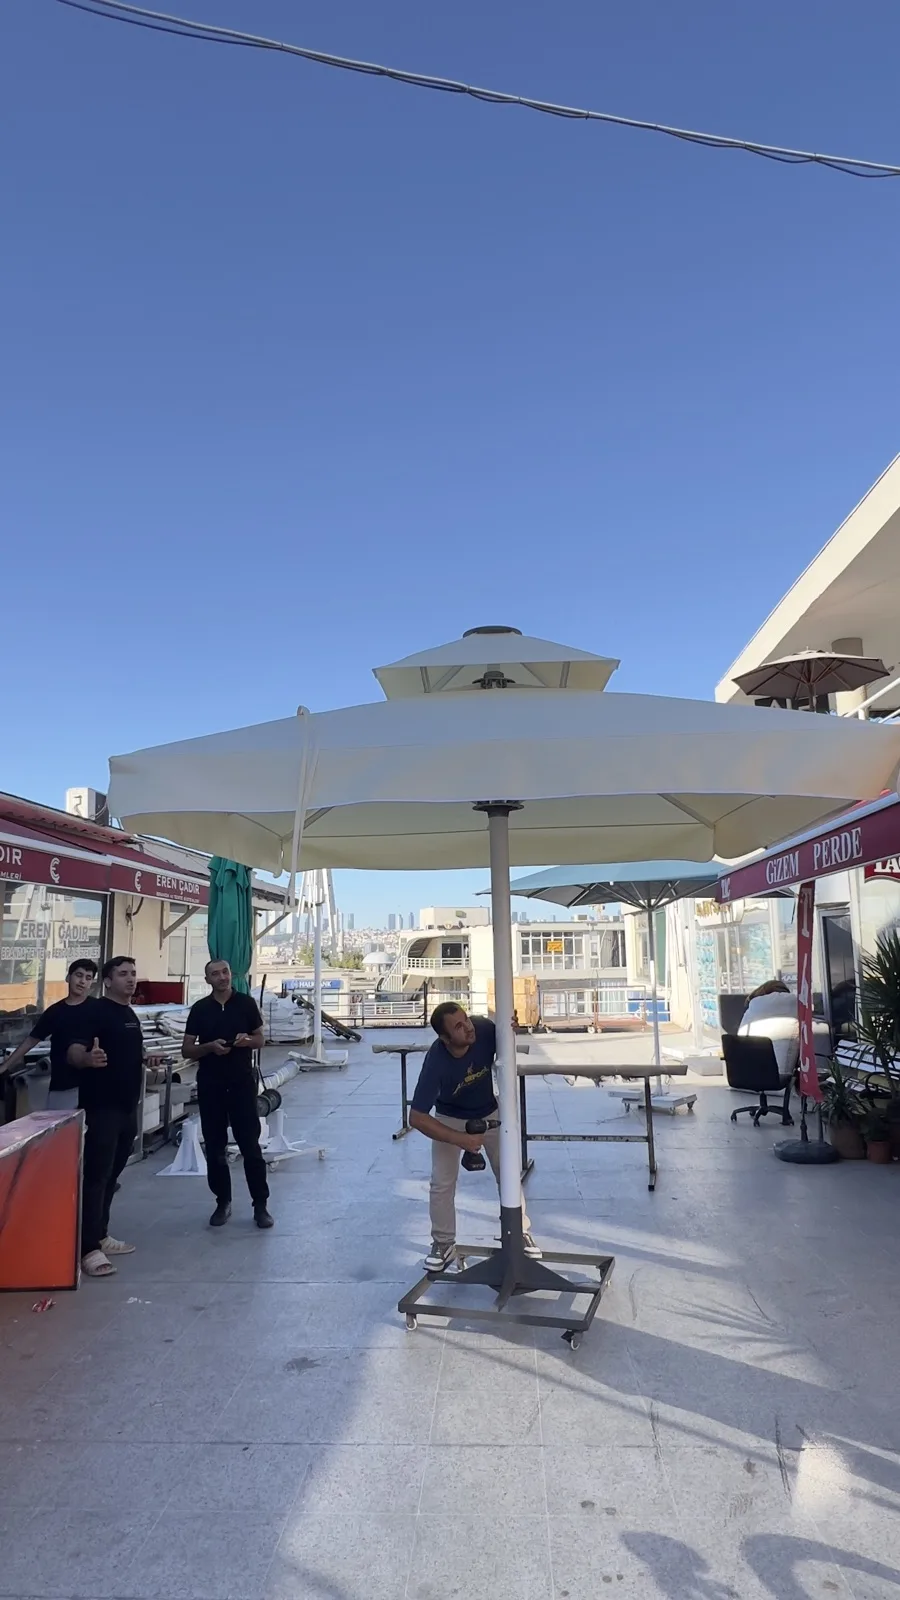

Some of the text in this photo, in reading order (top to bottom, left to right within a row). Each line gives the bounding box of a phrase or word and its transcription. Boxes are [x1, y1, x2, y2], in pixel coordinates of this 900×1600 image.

[813, 827, 863, 871] PERDE
[156, 875, 200, 895] EREN ÇADIR
[20, 922, 51, 940] EREN
